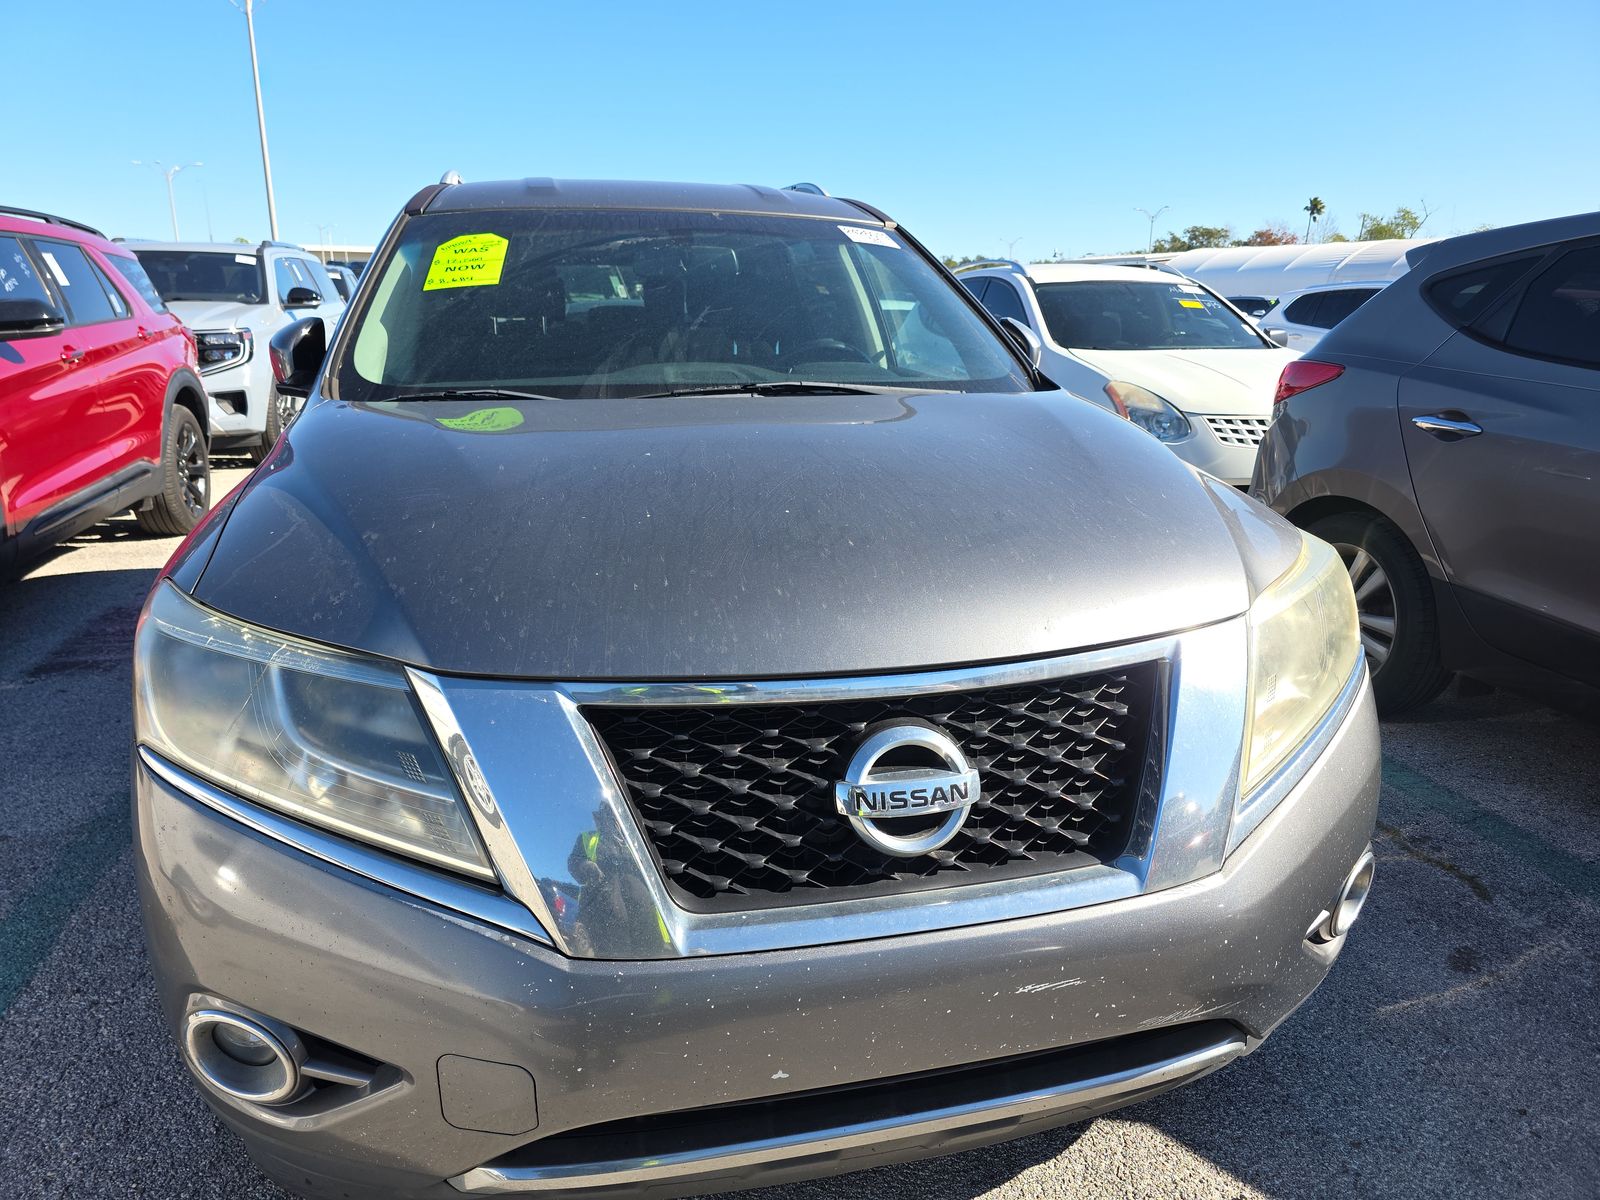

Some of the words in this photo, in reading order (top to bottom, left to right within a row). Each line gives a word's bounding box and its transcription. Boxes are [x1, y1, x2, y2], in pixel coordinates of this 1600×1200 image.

[453, 246, 489, 254] WAS
[445, 264, 486, 272] NOW
[855, 782, 969, 811] NISSAN
